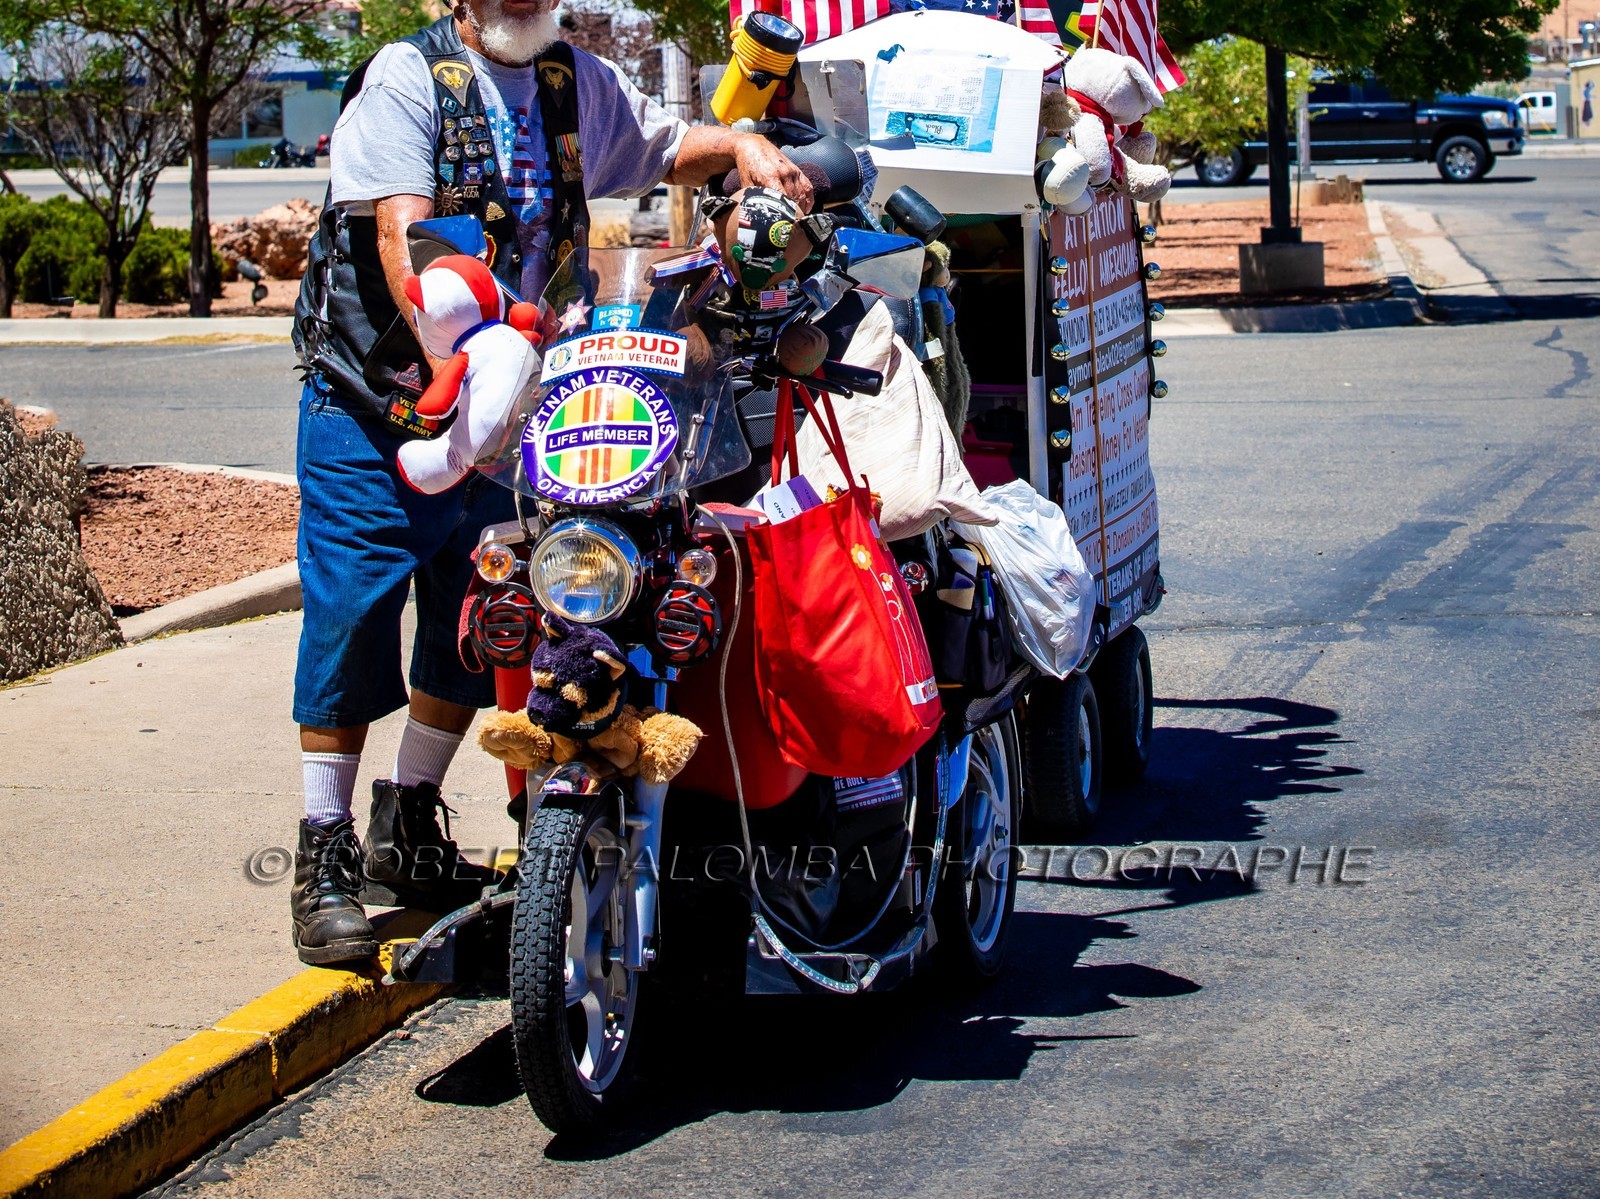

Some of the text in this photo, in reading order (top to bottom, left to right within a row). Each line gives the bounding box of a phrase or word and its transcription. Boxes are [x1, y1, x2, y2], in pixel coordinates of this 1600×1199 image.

[463, 185, 478, 193] VIET
[1064, 197, 1125, 250] ATTENTION
[1099, 239, 1139, 288] AMERICANS
[579, 336, 680, 356] PROUD
[577, 352, 624, 366] VIETNAM
[628, 353, 678, 367] VETERAN
[400, 396, 417, 411] VET
[523, 369, 677, 444] VIETNAM VETERANS
[1084, 388, 1116, 428] Traeling
[390, 414, 433, 438] U.S. ARMY
[549, 429, 649, 449] LIFE MEMBER
[1069, 443, 1097, 482] Raising
[537, 478, 562, 496] OF
[1092, 534, 1110, 563] YOR
